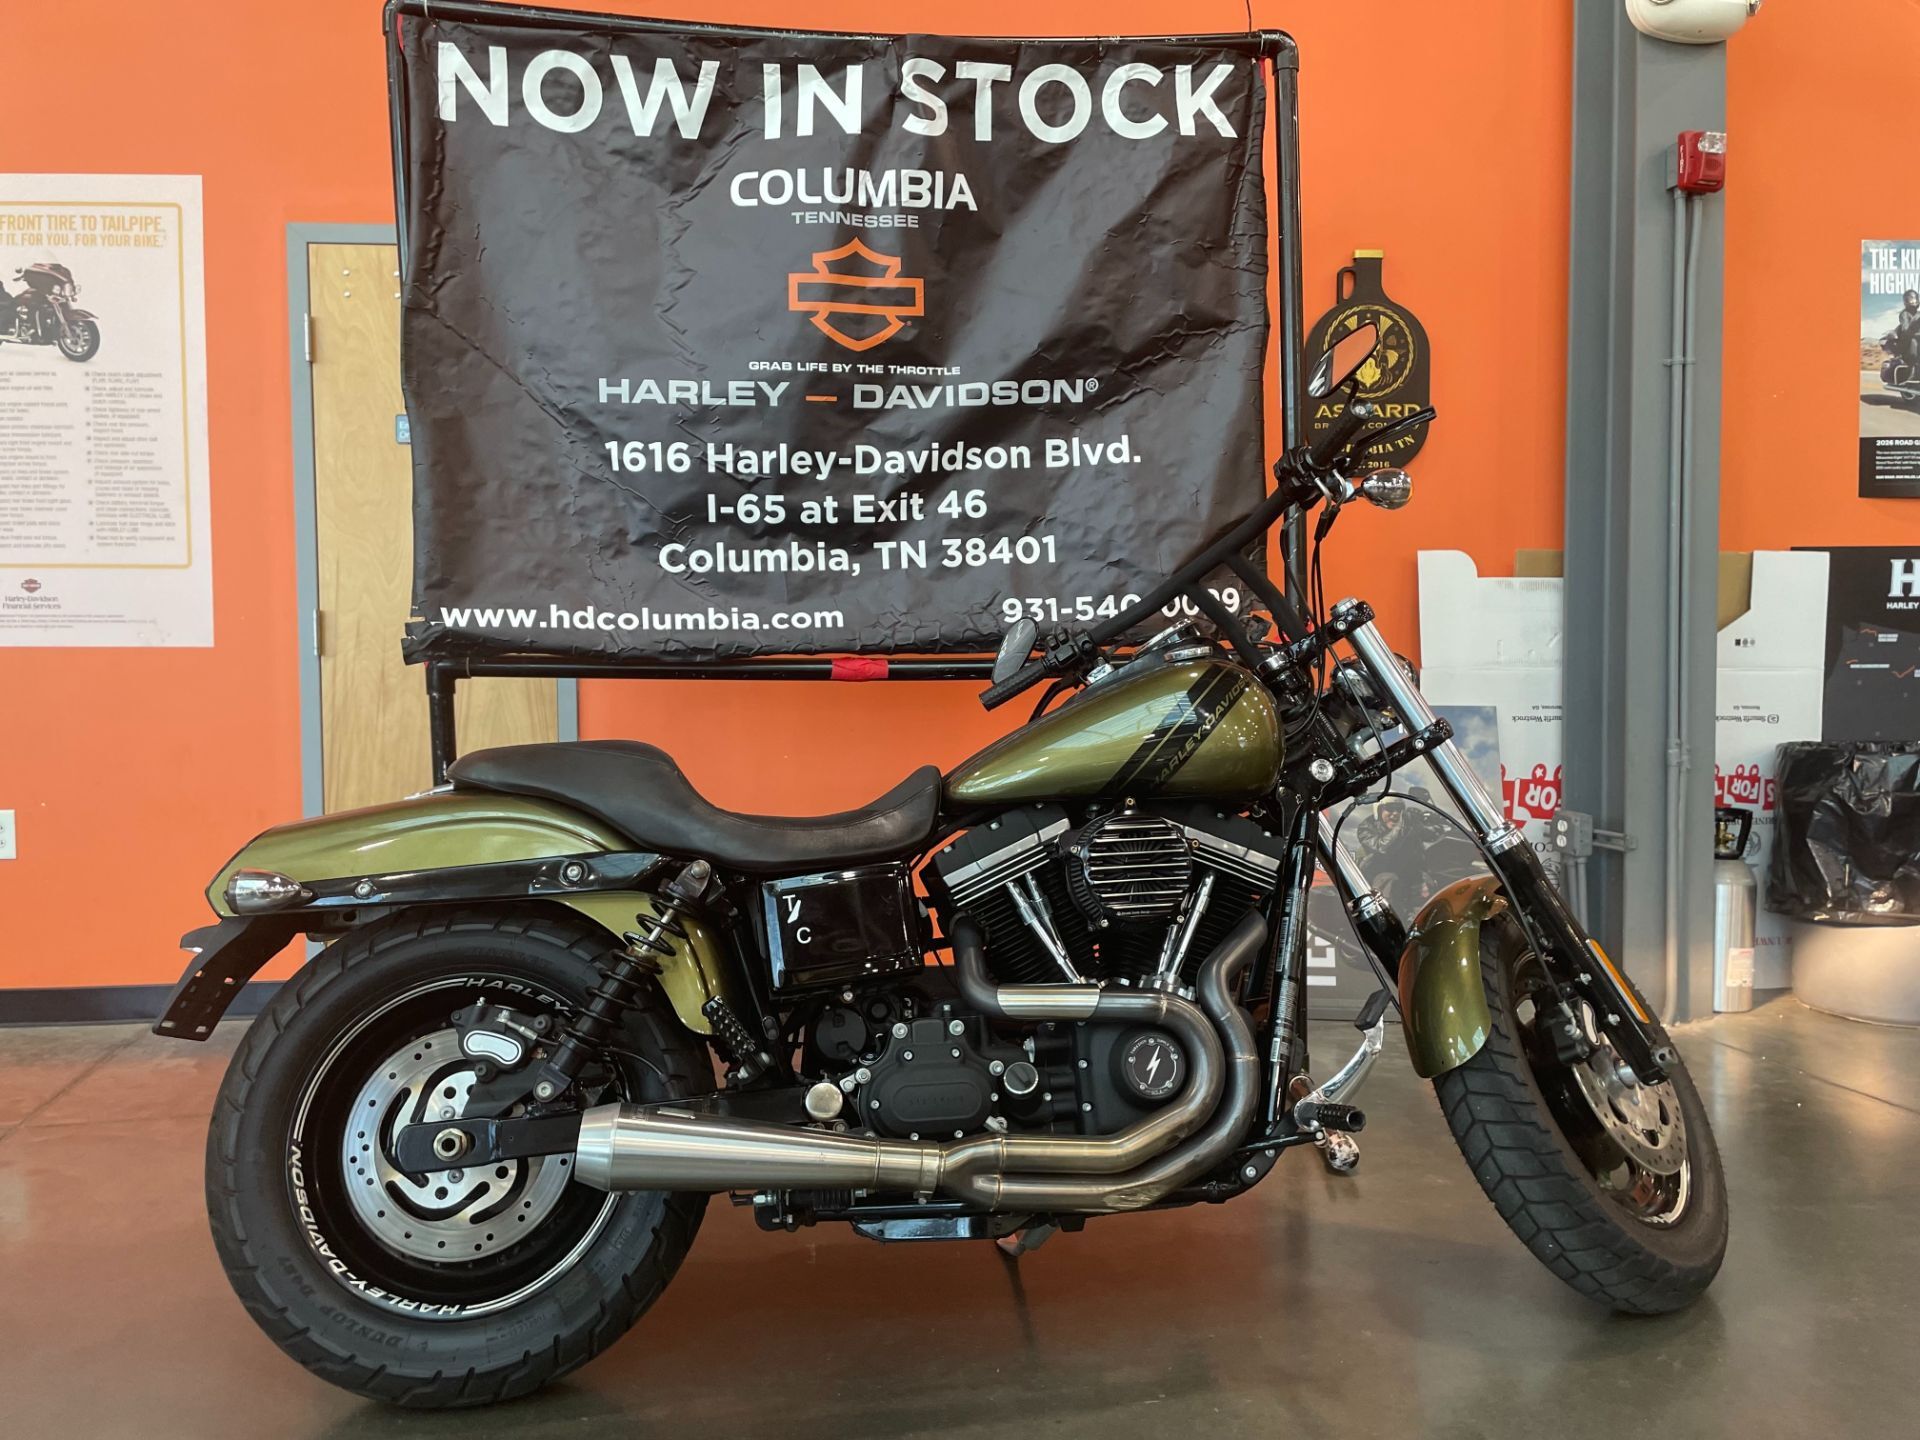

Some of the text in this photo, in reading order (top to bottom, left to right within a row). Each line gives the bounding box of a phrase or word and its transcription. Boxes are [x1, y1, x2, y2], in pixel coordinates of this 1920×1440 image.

[438, 41, 1238, 144] NOW IN STOCK
[729, 167, 978, 212] COLUMBIA
[47, 215, 77, 231] TIRE
[81, 215, 97, 231] TO
[790, 211, 919, 229] TENNESSEE
[21, 233, 43, 246] FOR
[75, 233, 97, 246] FOR
[101, 234, 131, 247] YOUR
[1869, 248, 1898, 270] THE
[1870, 272, 1920, 295] HIGHW
[749, 361, 961, 376] GRAB LIFE BY THE THROTTLE
[598, 377, 790, 407] HARLEY
[1314, 403, 1421, 418] ASARD
[604, 434, 1142, 480] 1616 Harley-Davidson Blvd.
[707, 489, 988, 524] I-65 at Exit 46
[658, 534, 1057, 577] Columbia, TN 38401
[440, 602, 845, 631] www.hdcolumbia.com
[1730, 776, 1759, 799] FOR
[291, 1146, 461, 1317] HARLEY-DAVIDSON
